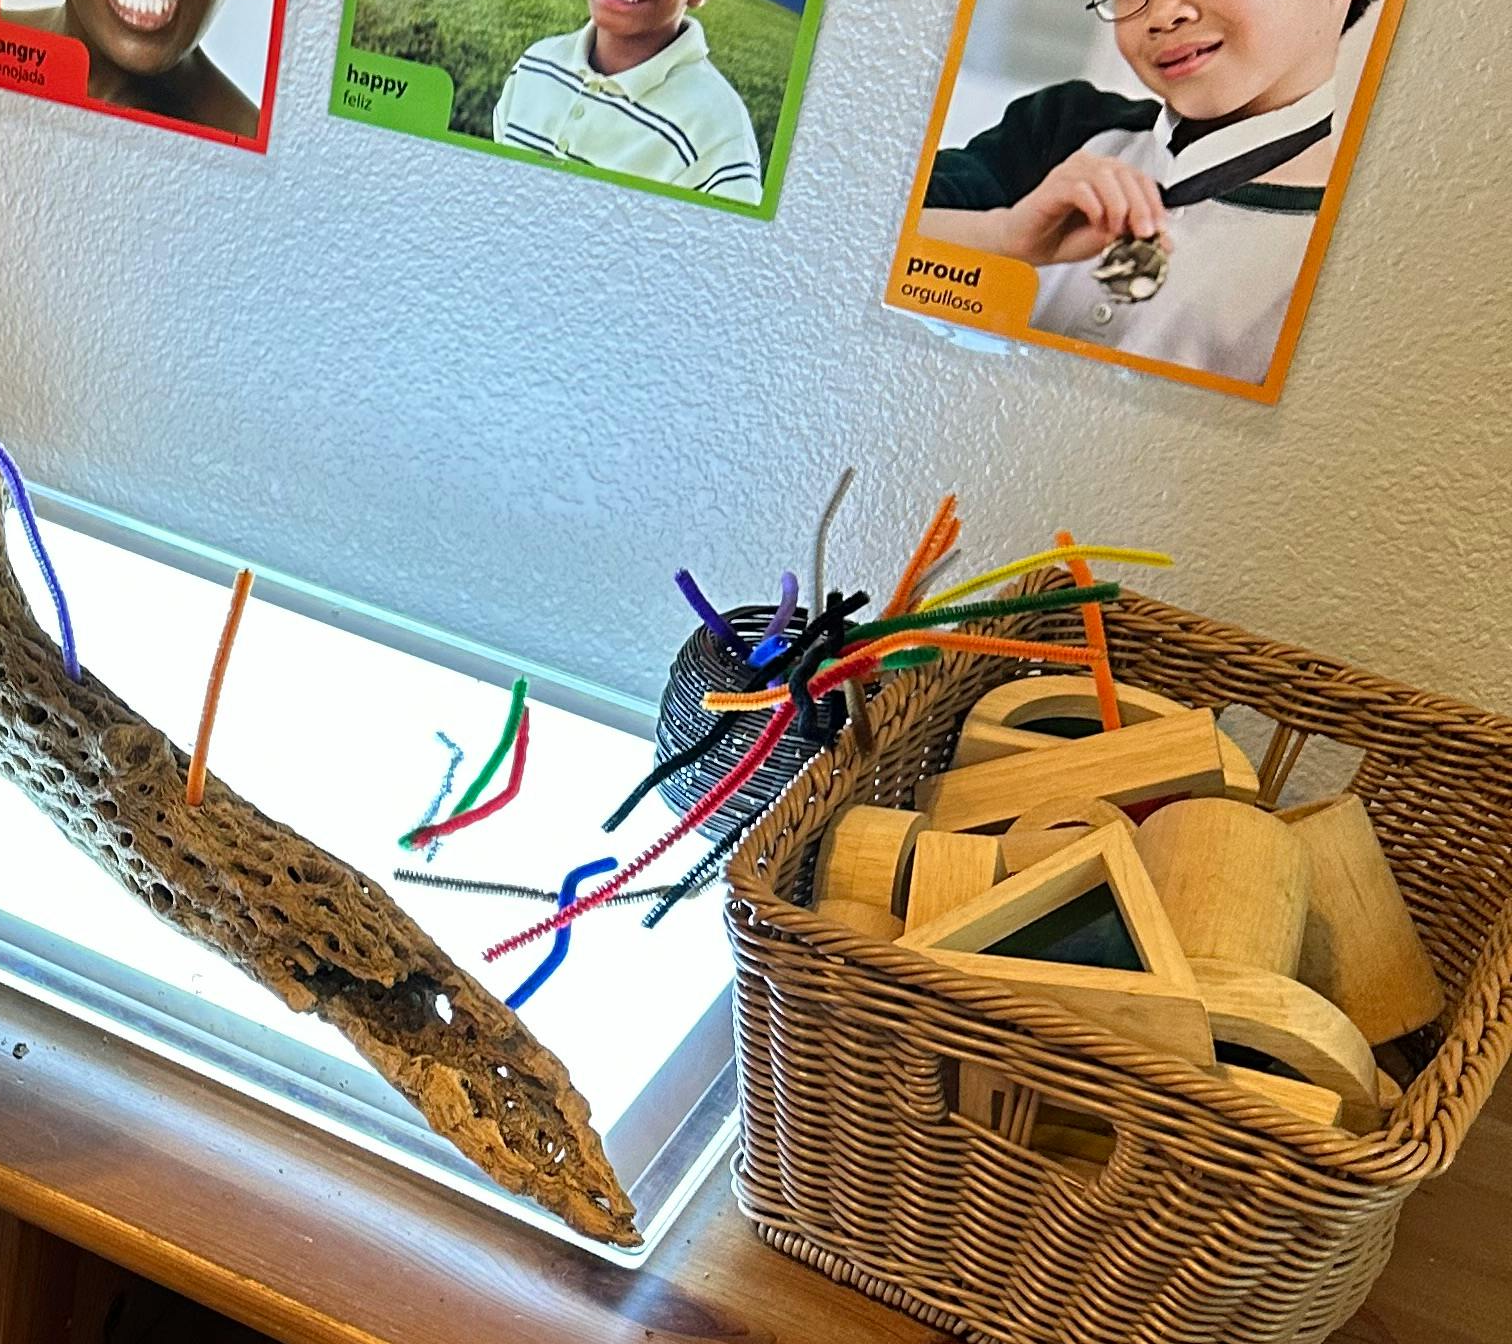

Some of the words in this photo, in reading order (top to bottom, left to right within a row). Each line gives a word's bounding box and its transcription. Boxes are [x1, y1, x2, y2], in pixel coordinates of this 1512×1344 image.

[346, 63, 408, 99] happy
[343, 89, 373, 112] feliz
[906, 256, 981, 287] proud
[901, 282, 983, 314] orgulloso
